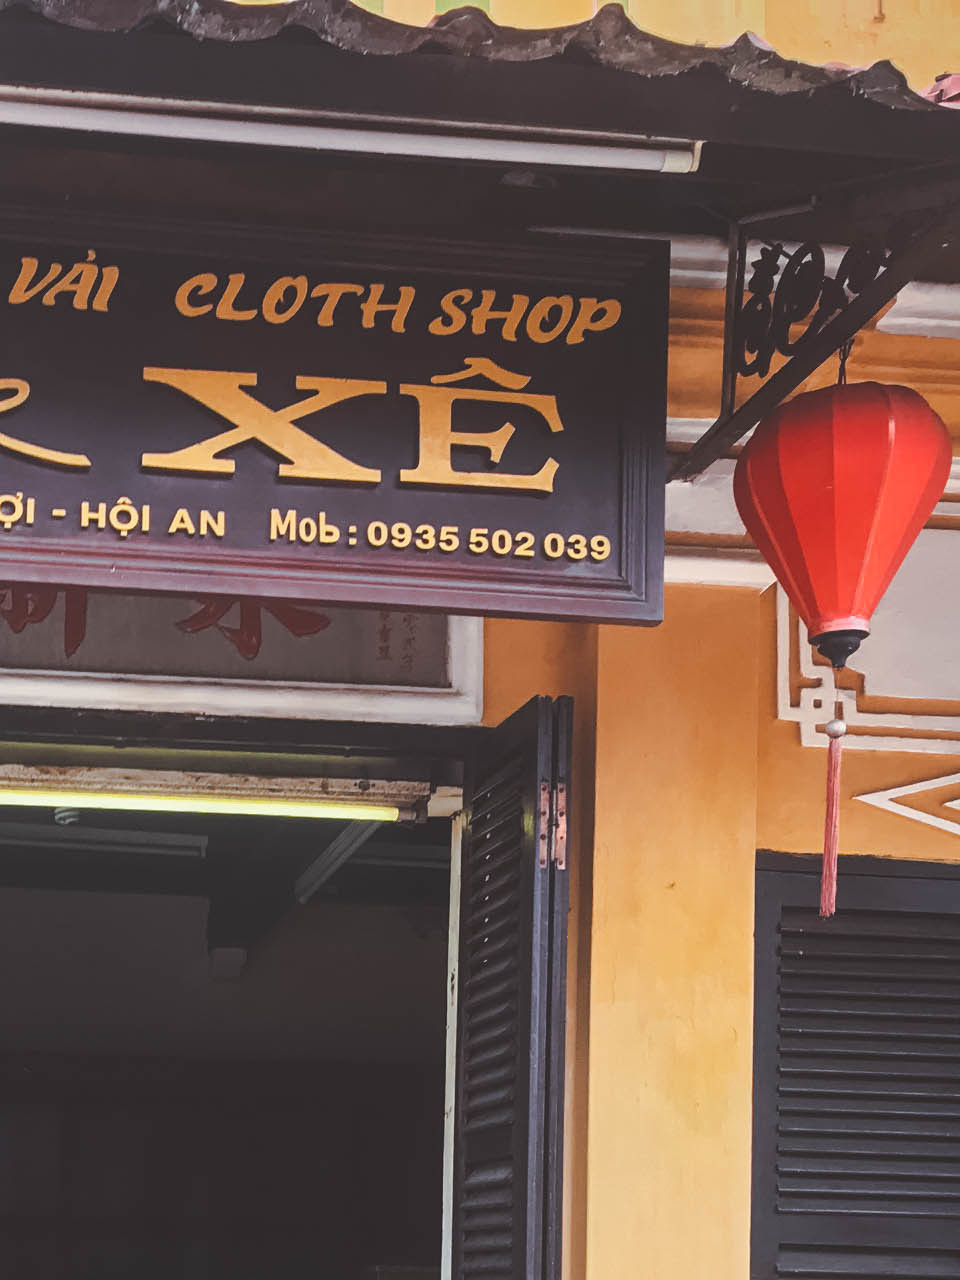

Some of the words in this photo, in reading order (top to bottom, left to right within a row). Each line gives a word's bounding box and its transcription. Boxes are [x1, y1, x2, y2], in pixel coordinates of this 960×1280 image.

[8, 249, 119, 312] VẢI
[174, 273, 415, 333] CLOTH
[428, 288, 622, 345] SHOP
[142, 357, 564, 493] XÊ
[80, 496, 150, 537] HỘI
[168, 508, 226, 537] AN
[367, 520, 460, 552] 0935
[468, 527, 536, 557] 502
[544, 532, 611, 561] 039
